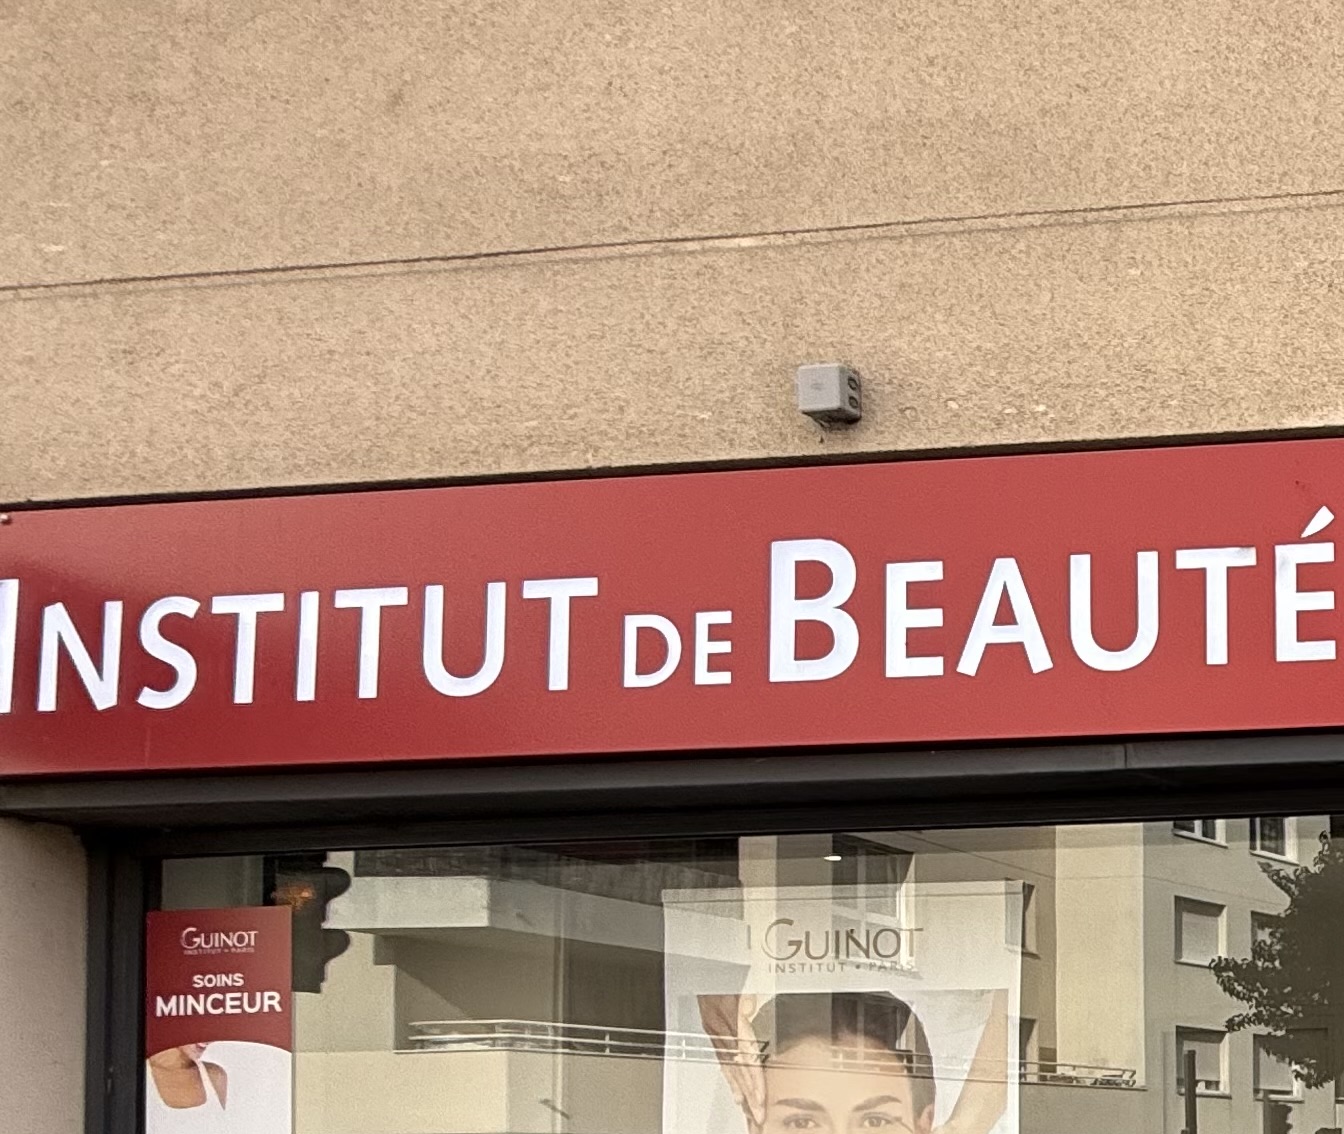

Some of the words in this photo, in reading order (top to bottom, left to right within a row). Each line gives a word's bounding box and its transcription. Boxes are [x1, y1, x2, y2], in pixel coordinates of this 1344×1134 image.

[0, 577, 598, 713] INSTITUT
[623, 611, 732, 688] DE
[769, 506, 1337, 682] BEAUTÉ
[181, 927, 259, 949] GUINOT
[761, 918, 924, 960] GUINOT
[769, 962, 846, 974] INSTITUT
[192, 973, 245, 988] SOINS
[156, 991, 283, 1017] MINCEUR
